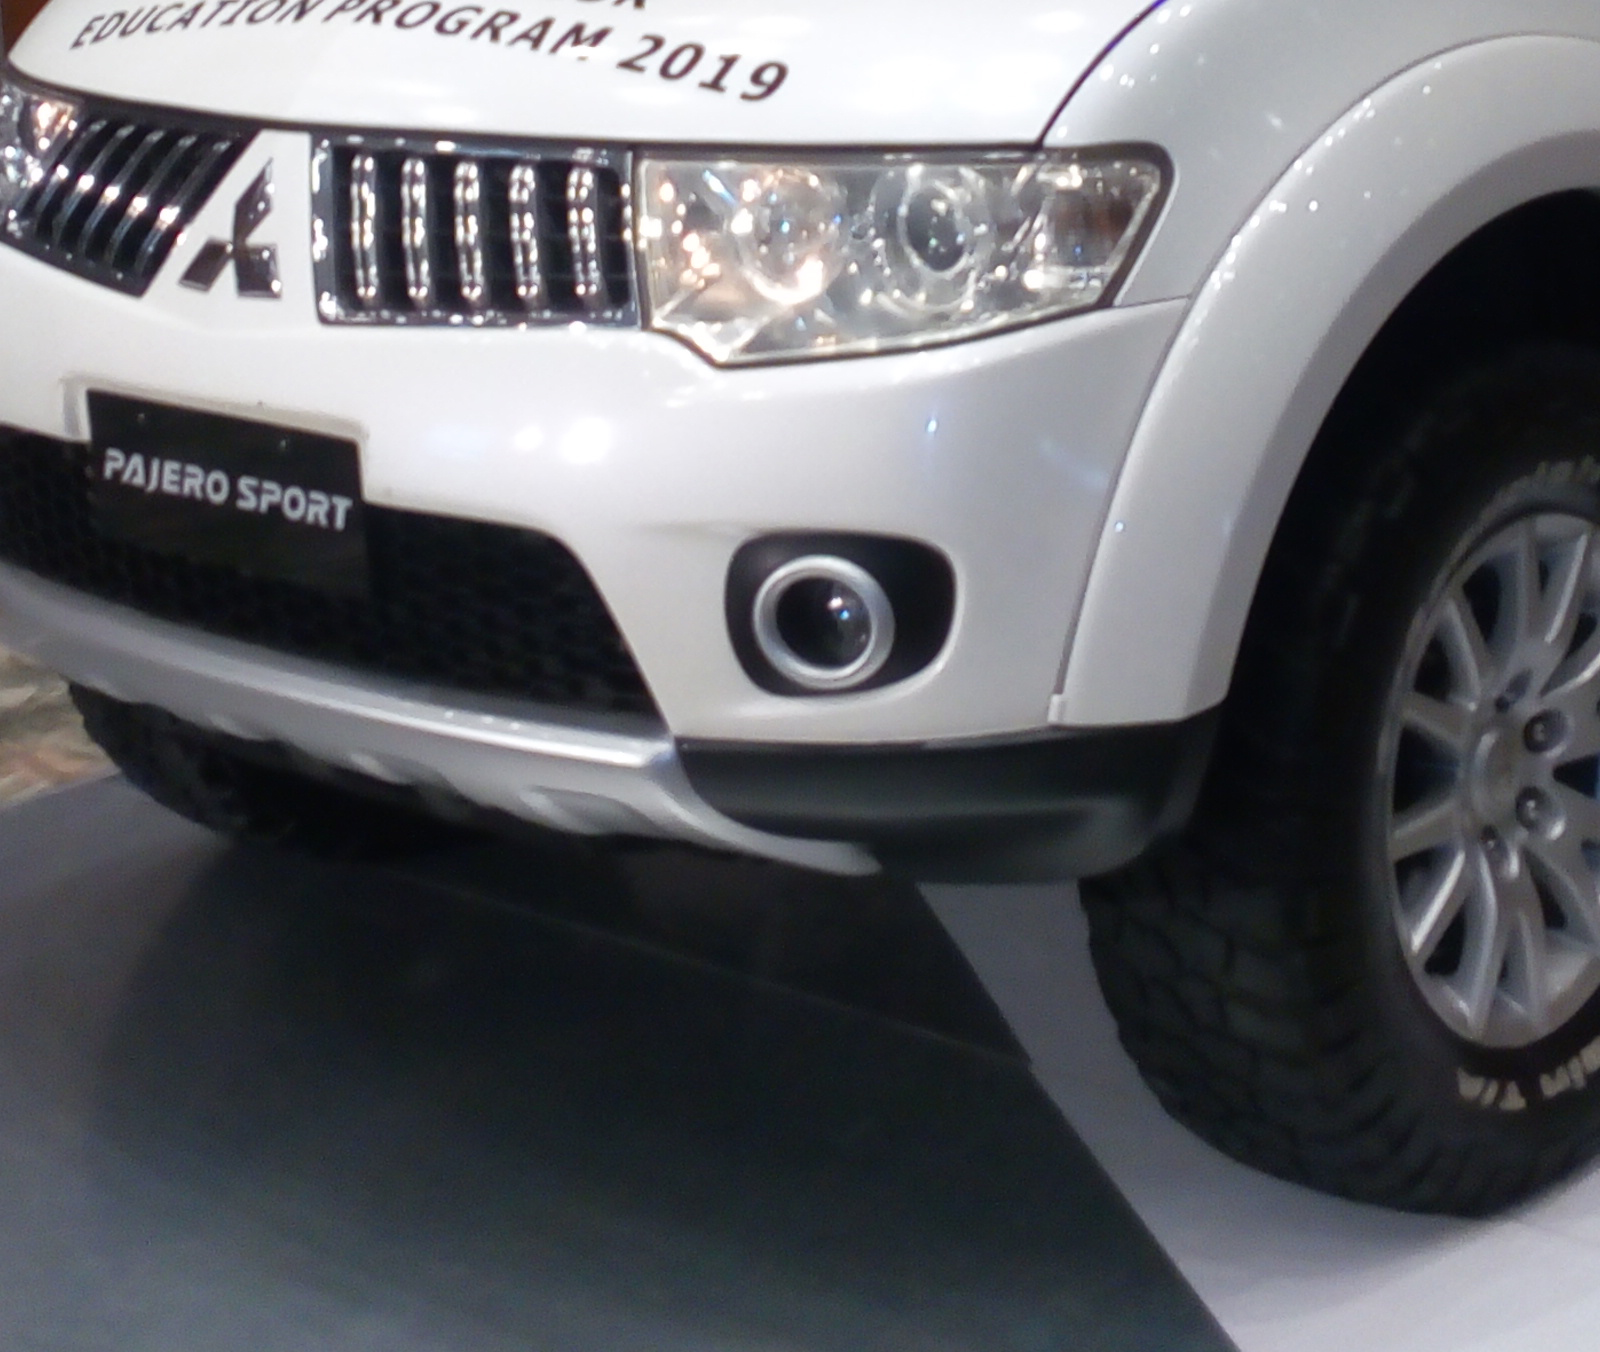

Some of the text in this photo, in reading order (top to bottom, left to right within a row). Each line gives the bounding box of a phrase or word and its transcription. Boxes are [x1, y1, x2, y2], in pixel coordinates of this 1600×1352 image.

[618, 33, 790, 104] 2019
[103, 447, 353, 532] PAJERO SPORT
